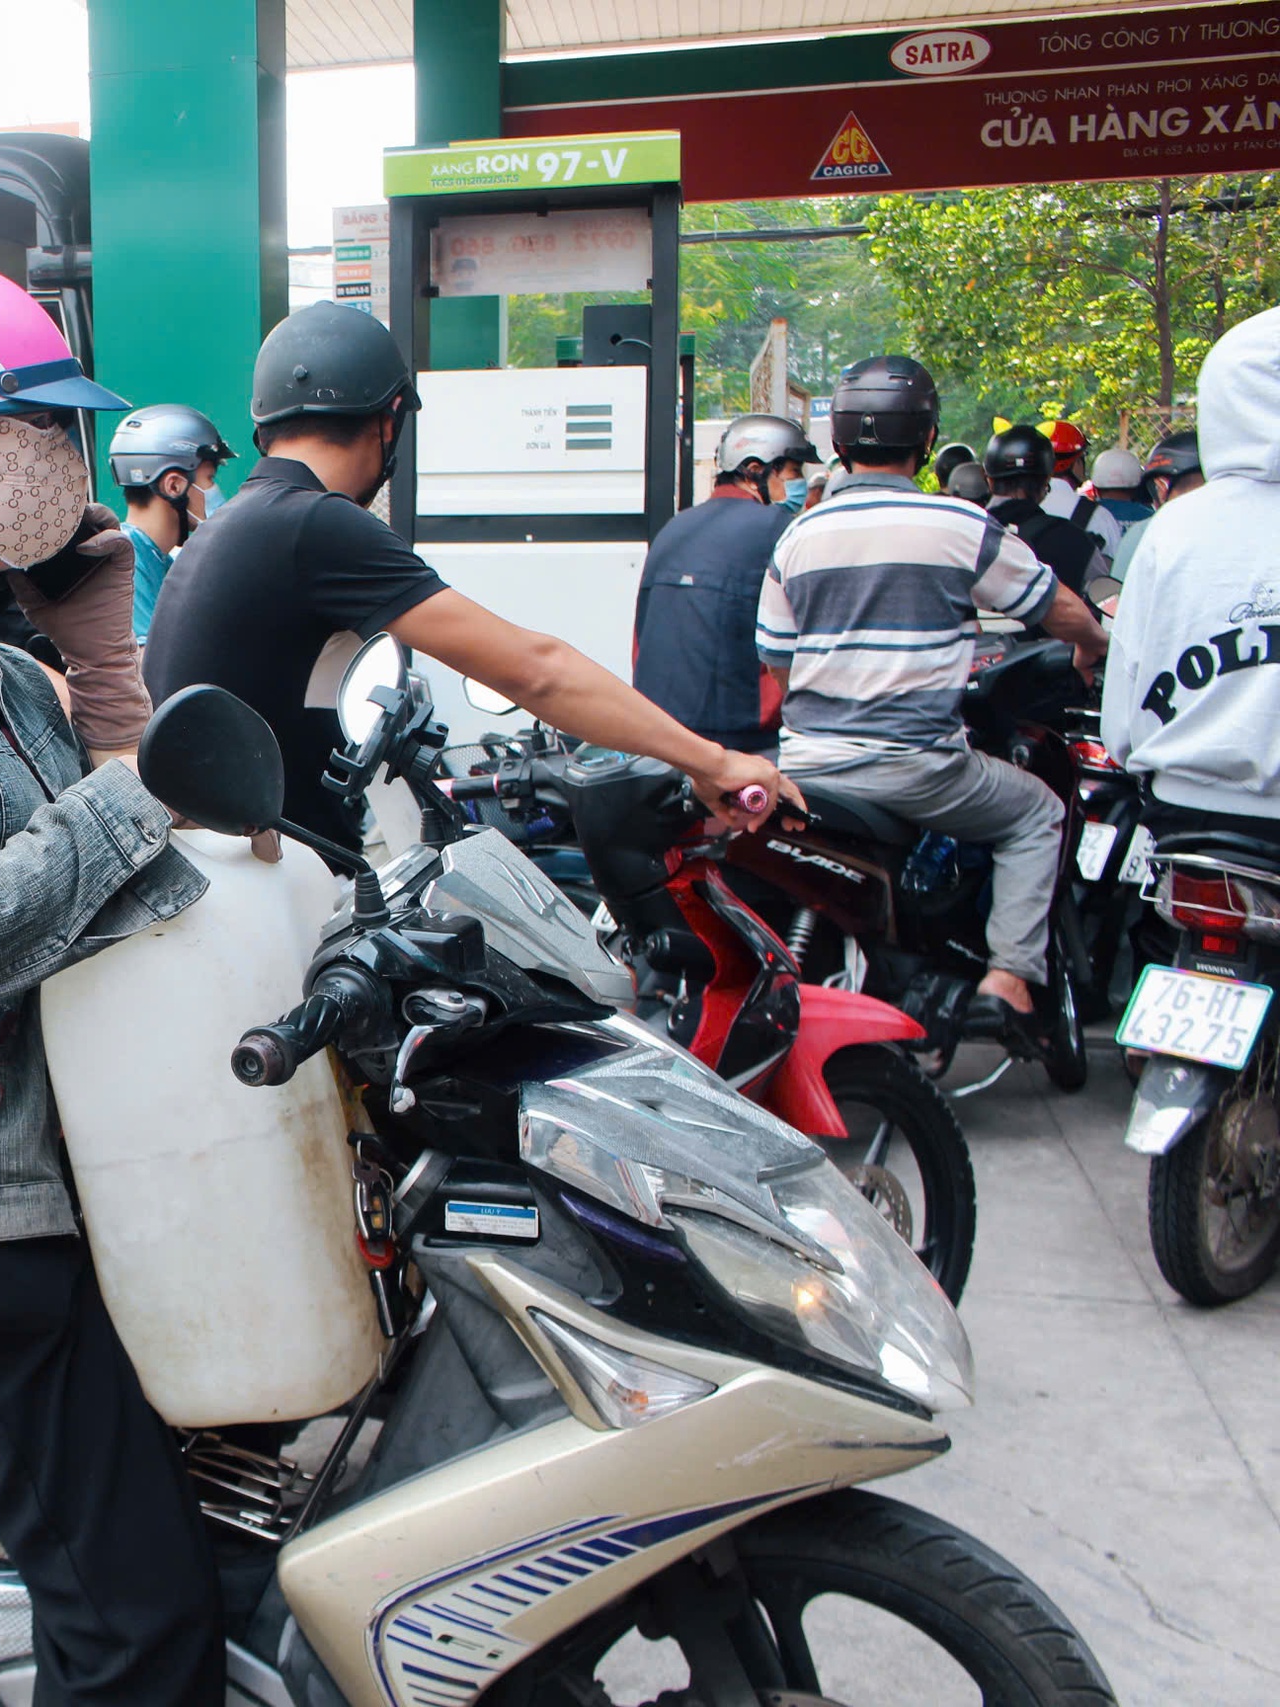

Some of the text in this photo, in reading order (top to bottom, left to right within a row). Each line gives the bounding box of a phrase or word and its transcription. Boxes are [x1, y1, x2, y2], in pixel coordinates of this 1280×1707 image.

[1101, 26, 1160, 49] CÔNG
[1169, 25, 1191, 43] TY
[905, 40, 975, 66] SATRA
[980, 106, 1056, 148] CỬA
[1069, 102, 1191, 144] HÀNG
[476, 153, 529, 174] RON
[536, 148, 628, 182] 97-V
[823, 163, 879, 177] CAGICO
[1196, 962, 1236, 976] HONDA
[1153, 976, 1247, 1022] 76-H1
[1129, 1007, 1248, 1060] 432.75
